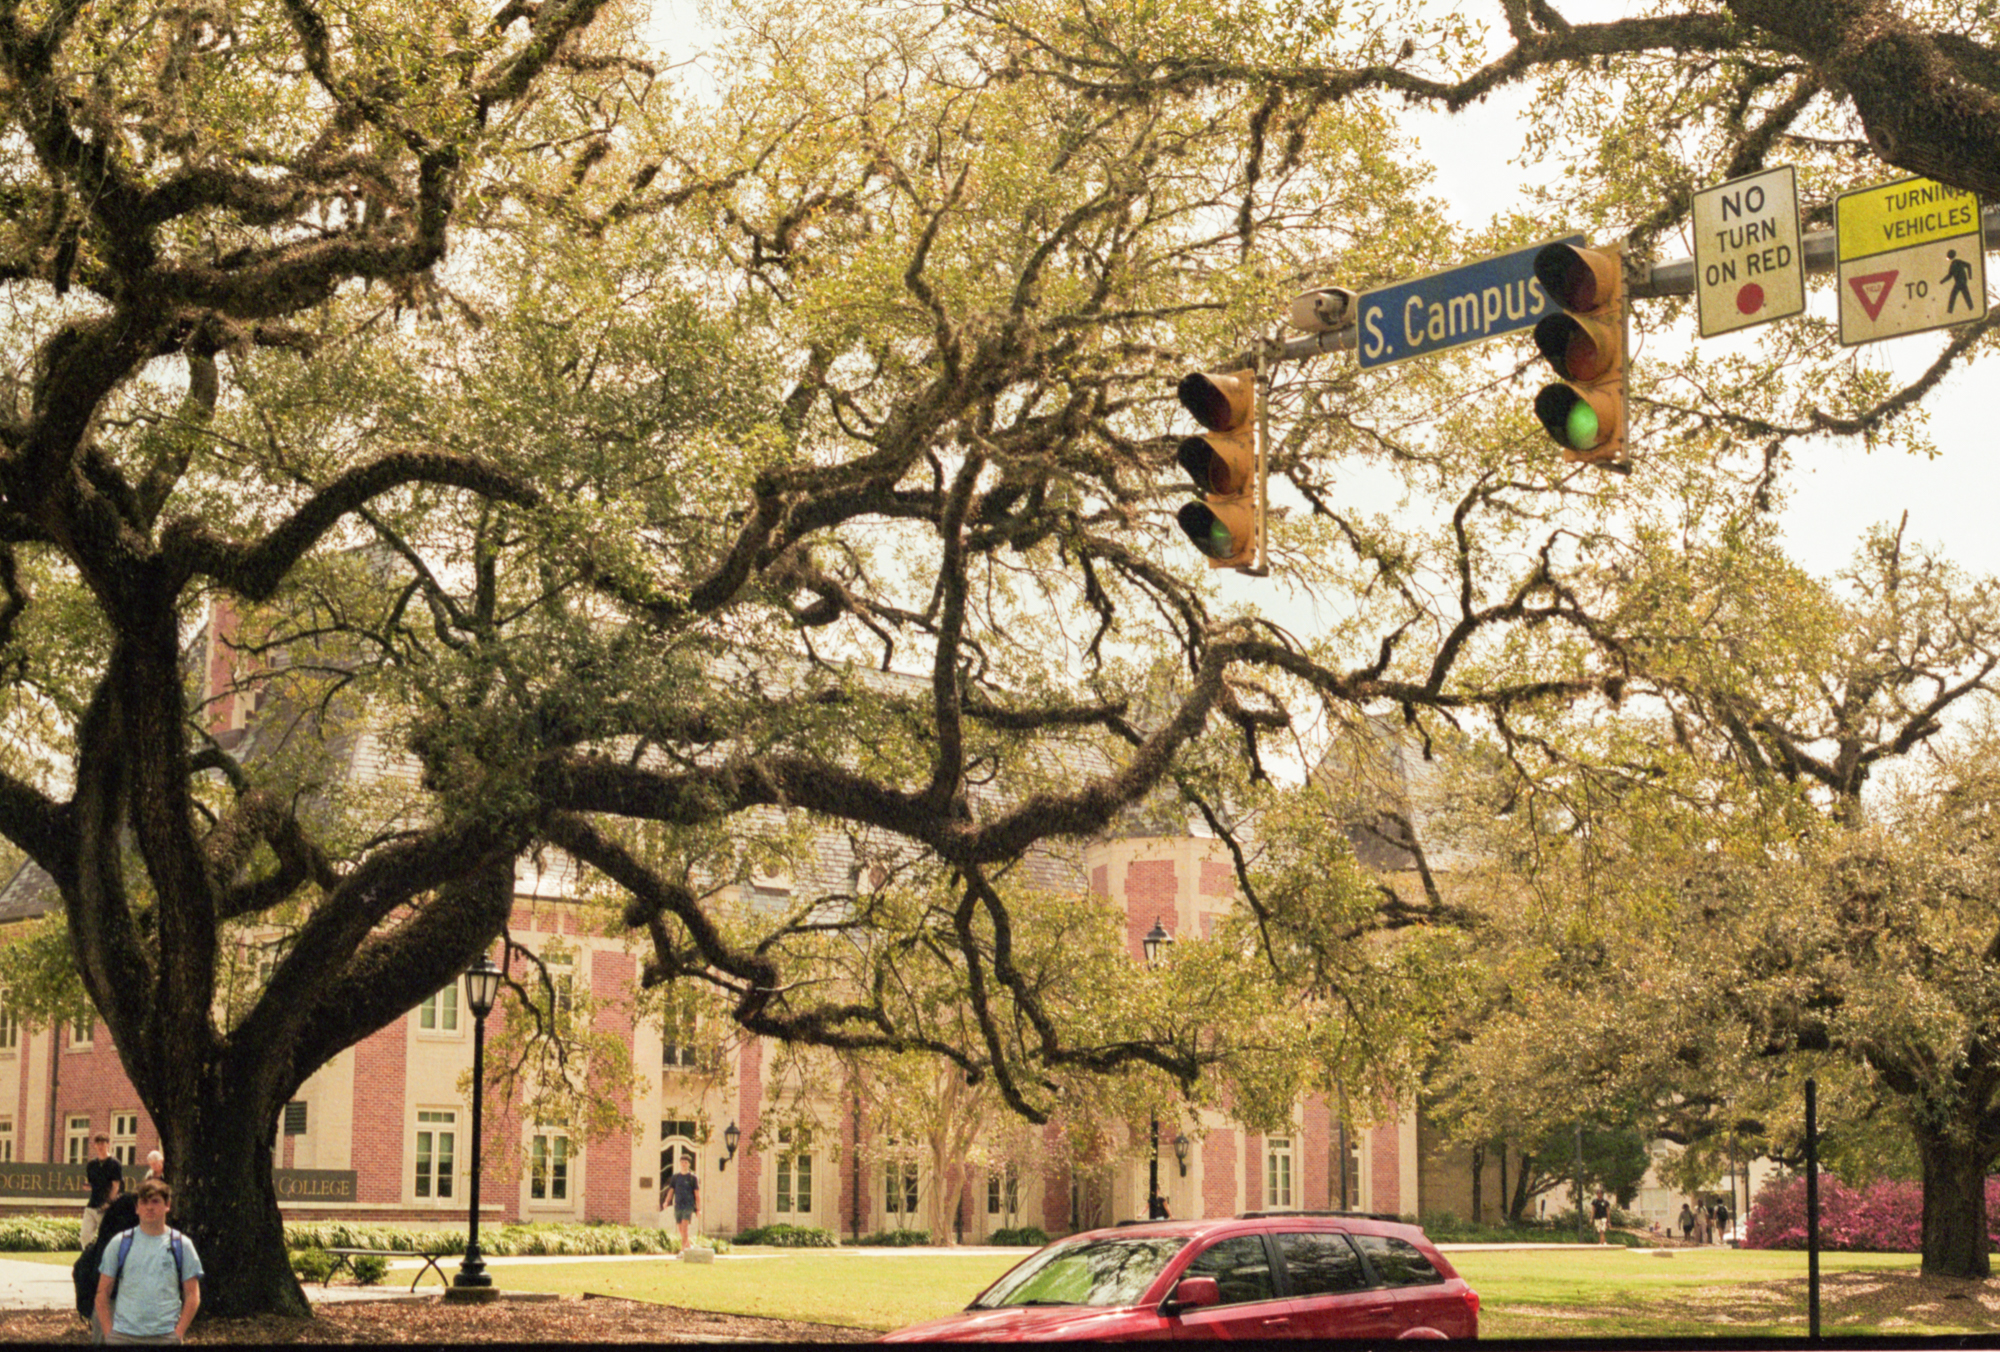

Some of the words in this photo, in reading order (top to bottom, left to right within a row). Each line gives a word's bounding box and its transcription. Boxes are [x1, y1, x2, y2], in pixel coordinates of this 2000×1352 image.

[1721, 185, 1765, 222] NO
[1716, 217, 1777, 253] TURN
[1883, 205, 1971, 240] VEHICLES
[1705, 260, 1736, 288] ON
[1746, 245, 1792, 277] RED
[1904, 280, 1928, 300] TO
[1364, 306, 1393, 358] S.
[1405, 275, 1545, 346] Campus
[278, 1176, 350, 1196] COLLEGE
